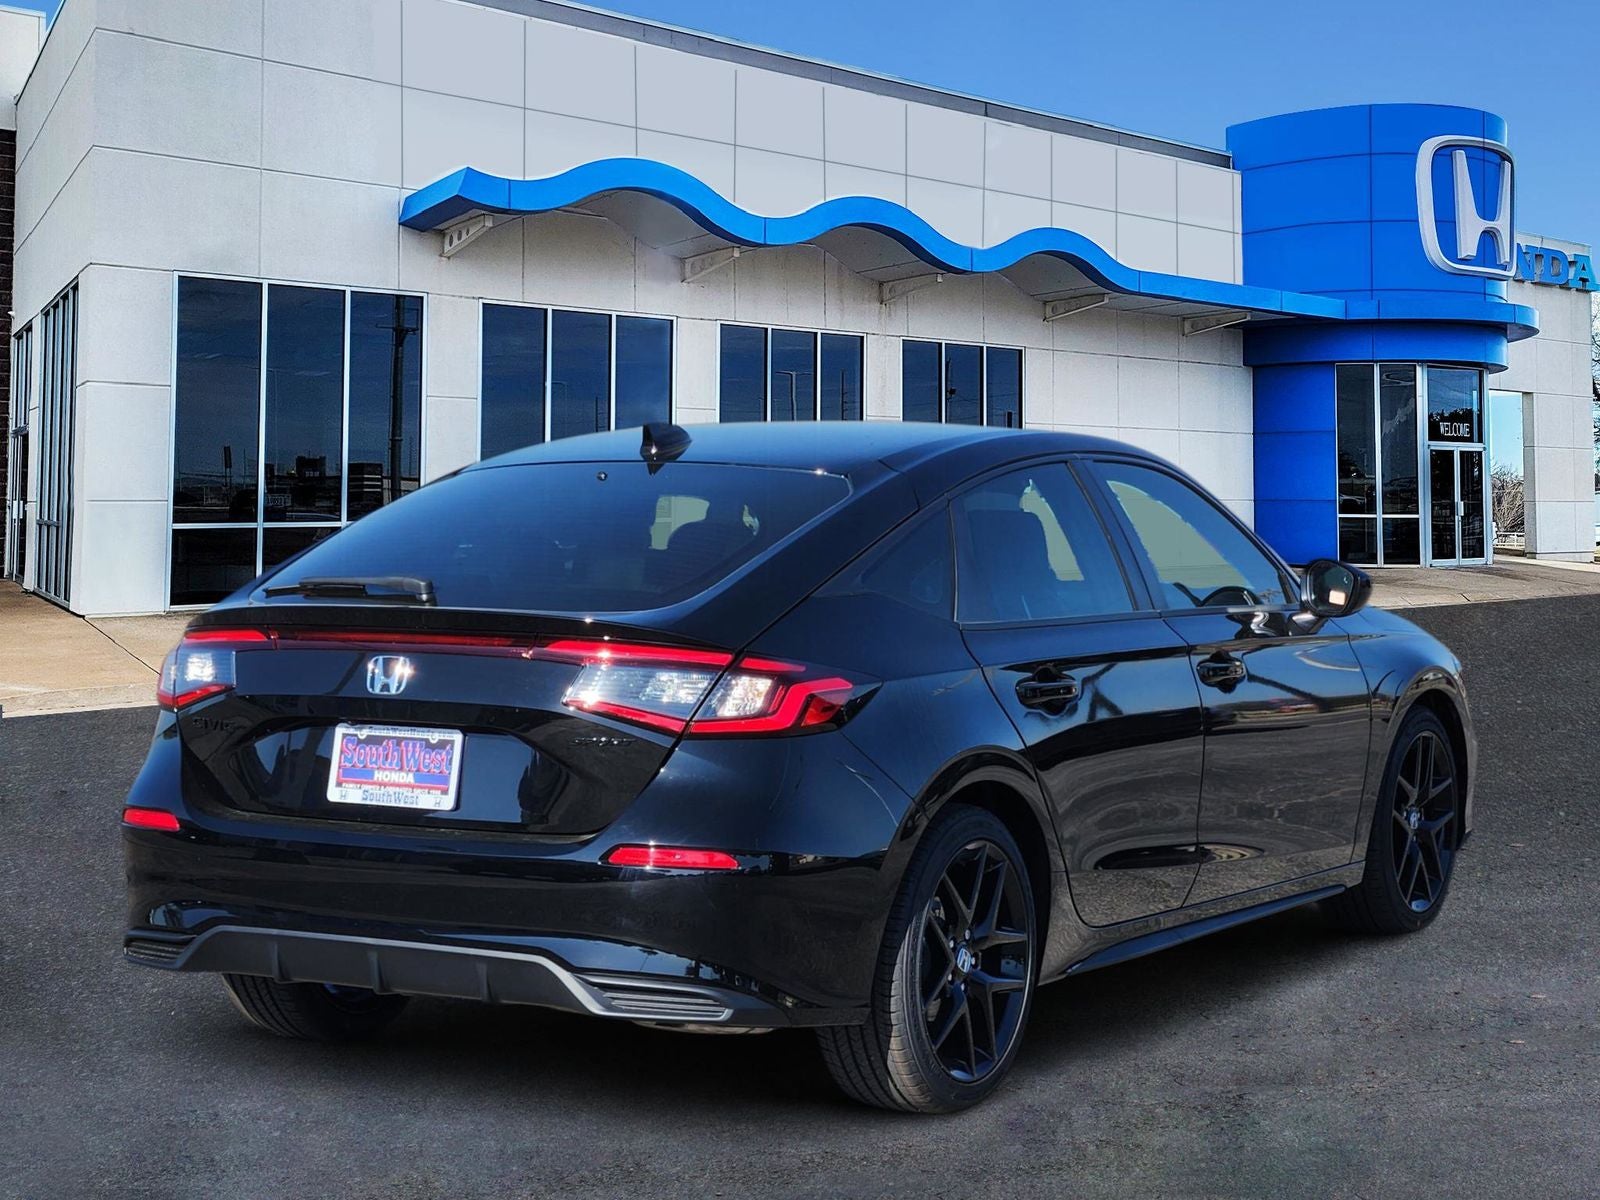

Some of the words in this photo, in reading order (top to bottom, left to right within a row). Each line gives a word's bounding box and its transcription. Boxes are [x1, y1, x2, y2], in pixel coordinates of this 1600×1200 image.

[1514, 242, 1600, 291] NDA
[1439, 421, 1471, 437] WELCOME
[373, 770, 415, 784] HONDA
[361, 789, 420, 806] SouthWest
